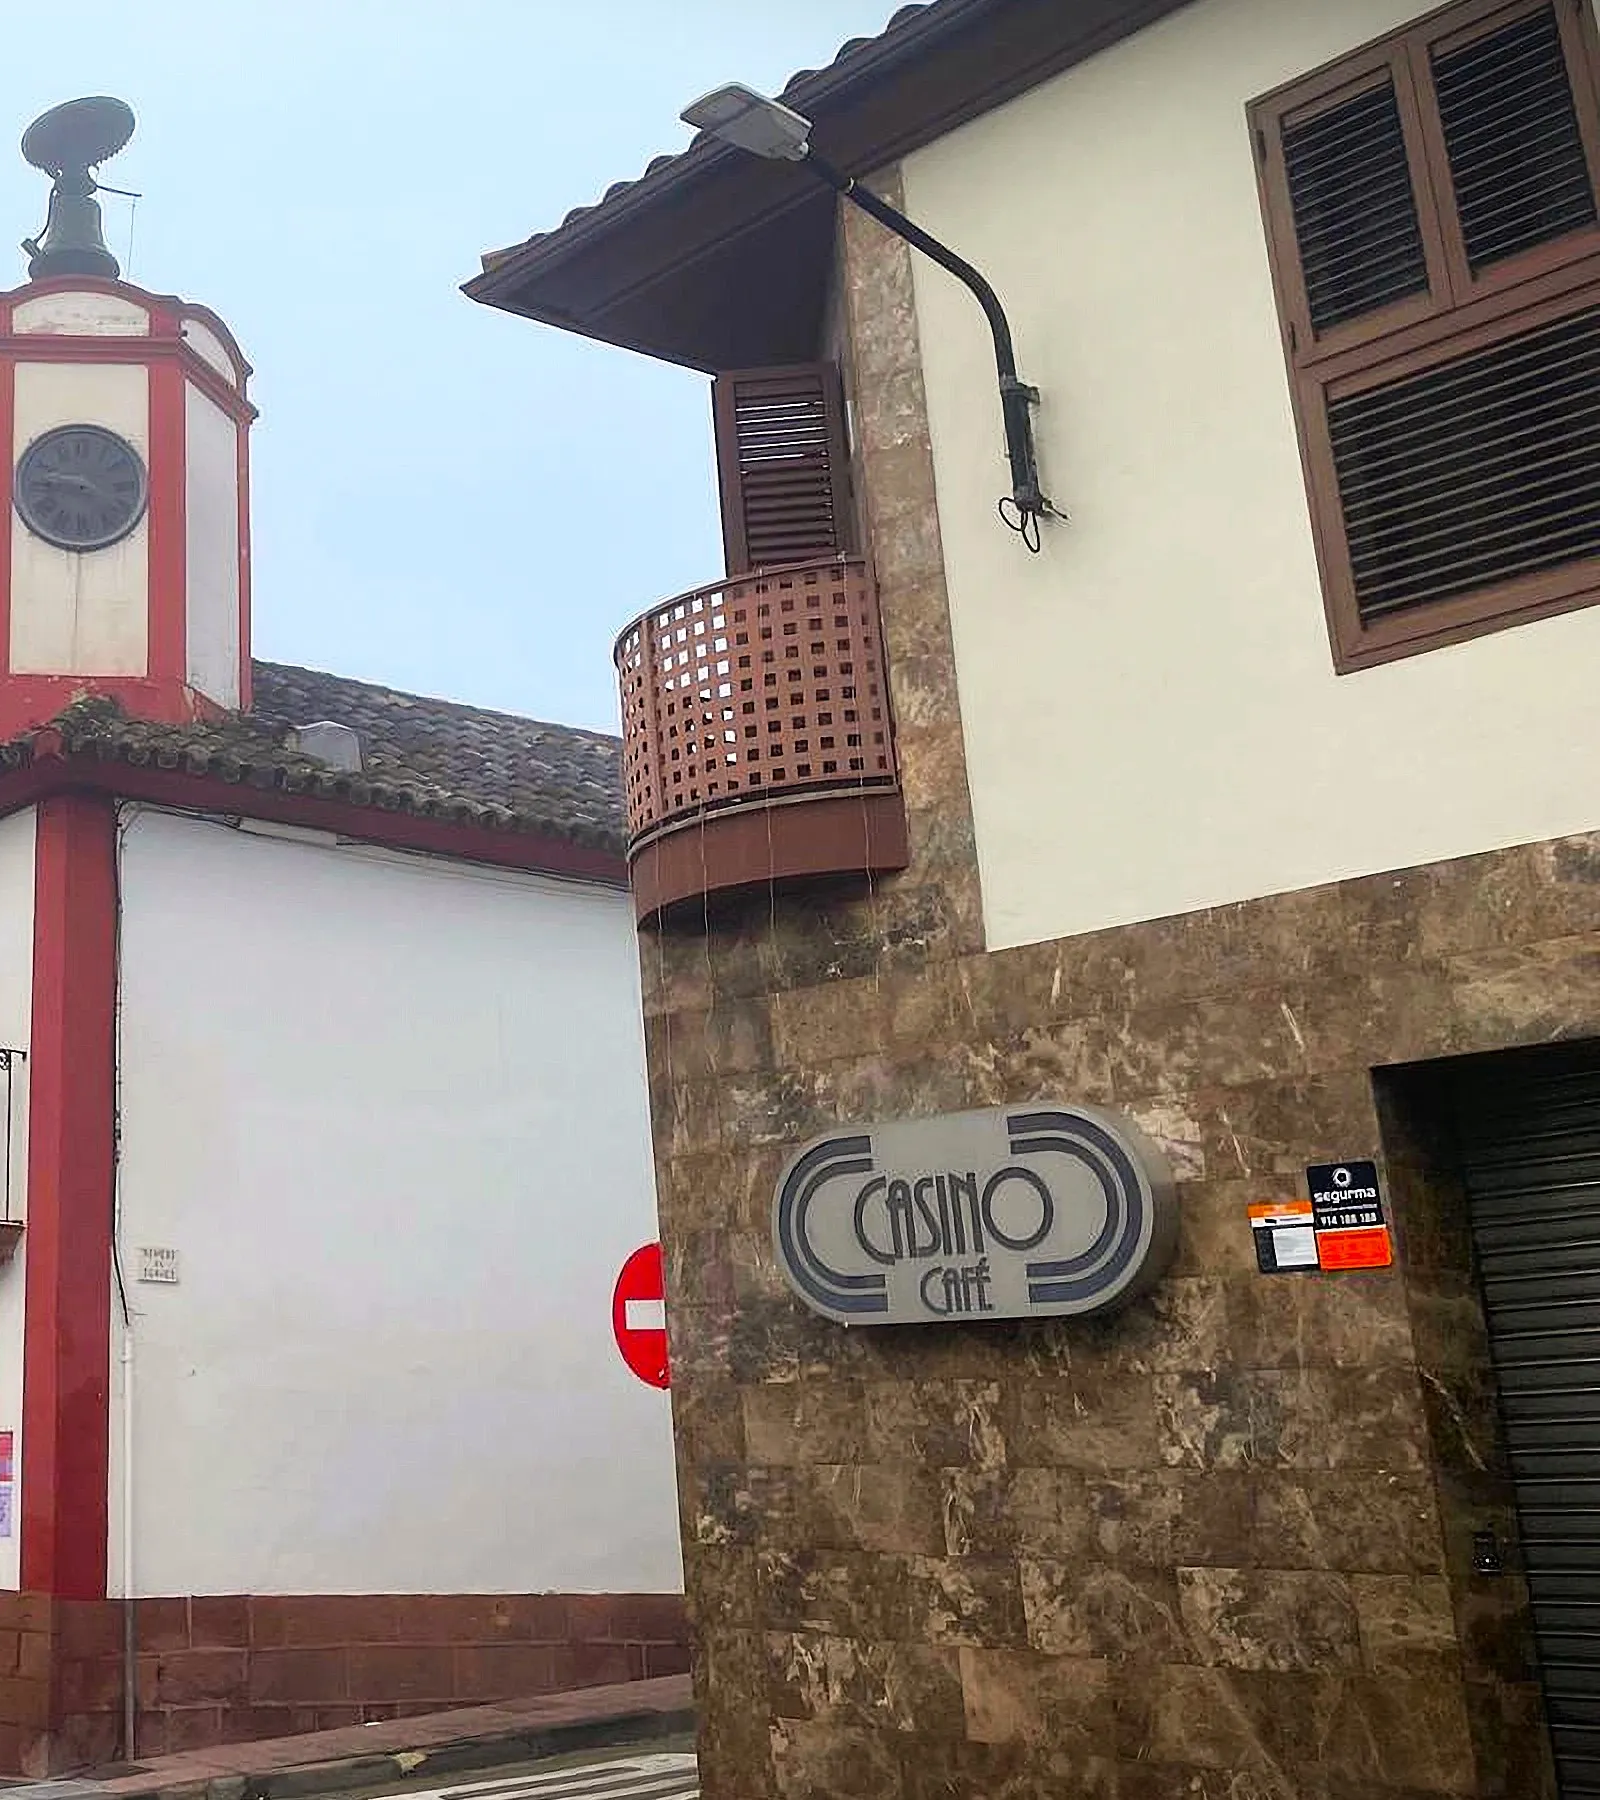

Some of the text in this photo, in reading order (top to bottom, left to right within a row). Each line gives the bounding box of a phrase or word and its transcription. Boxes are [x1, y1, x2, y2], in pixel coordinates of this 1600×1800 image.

[853, 1166, 1054, 1266] CASINO
[1313, 1187, 1377, 1204] segurma
[919, 1256, 993, 1316] CAFÉ
